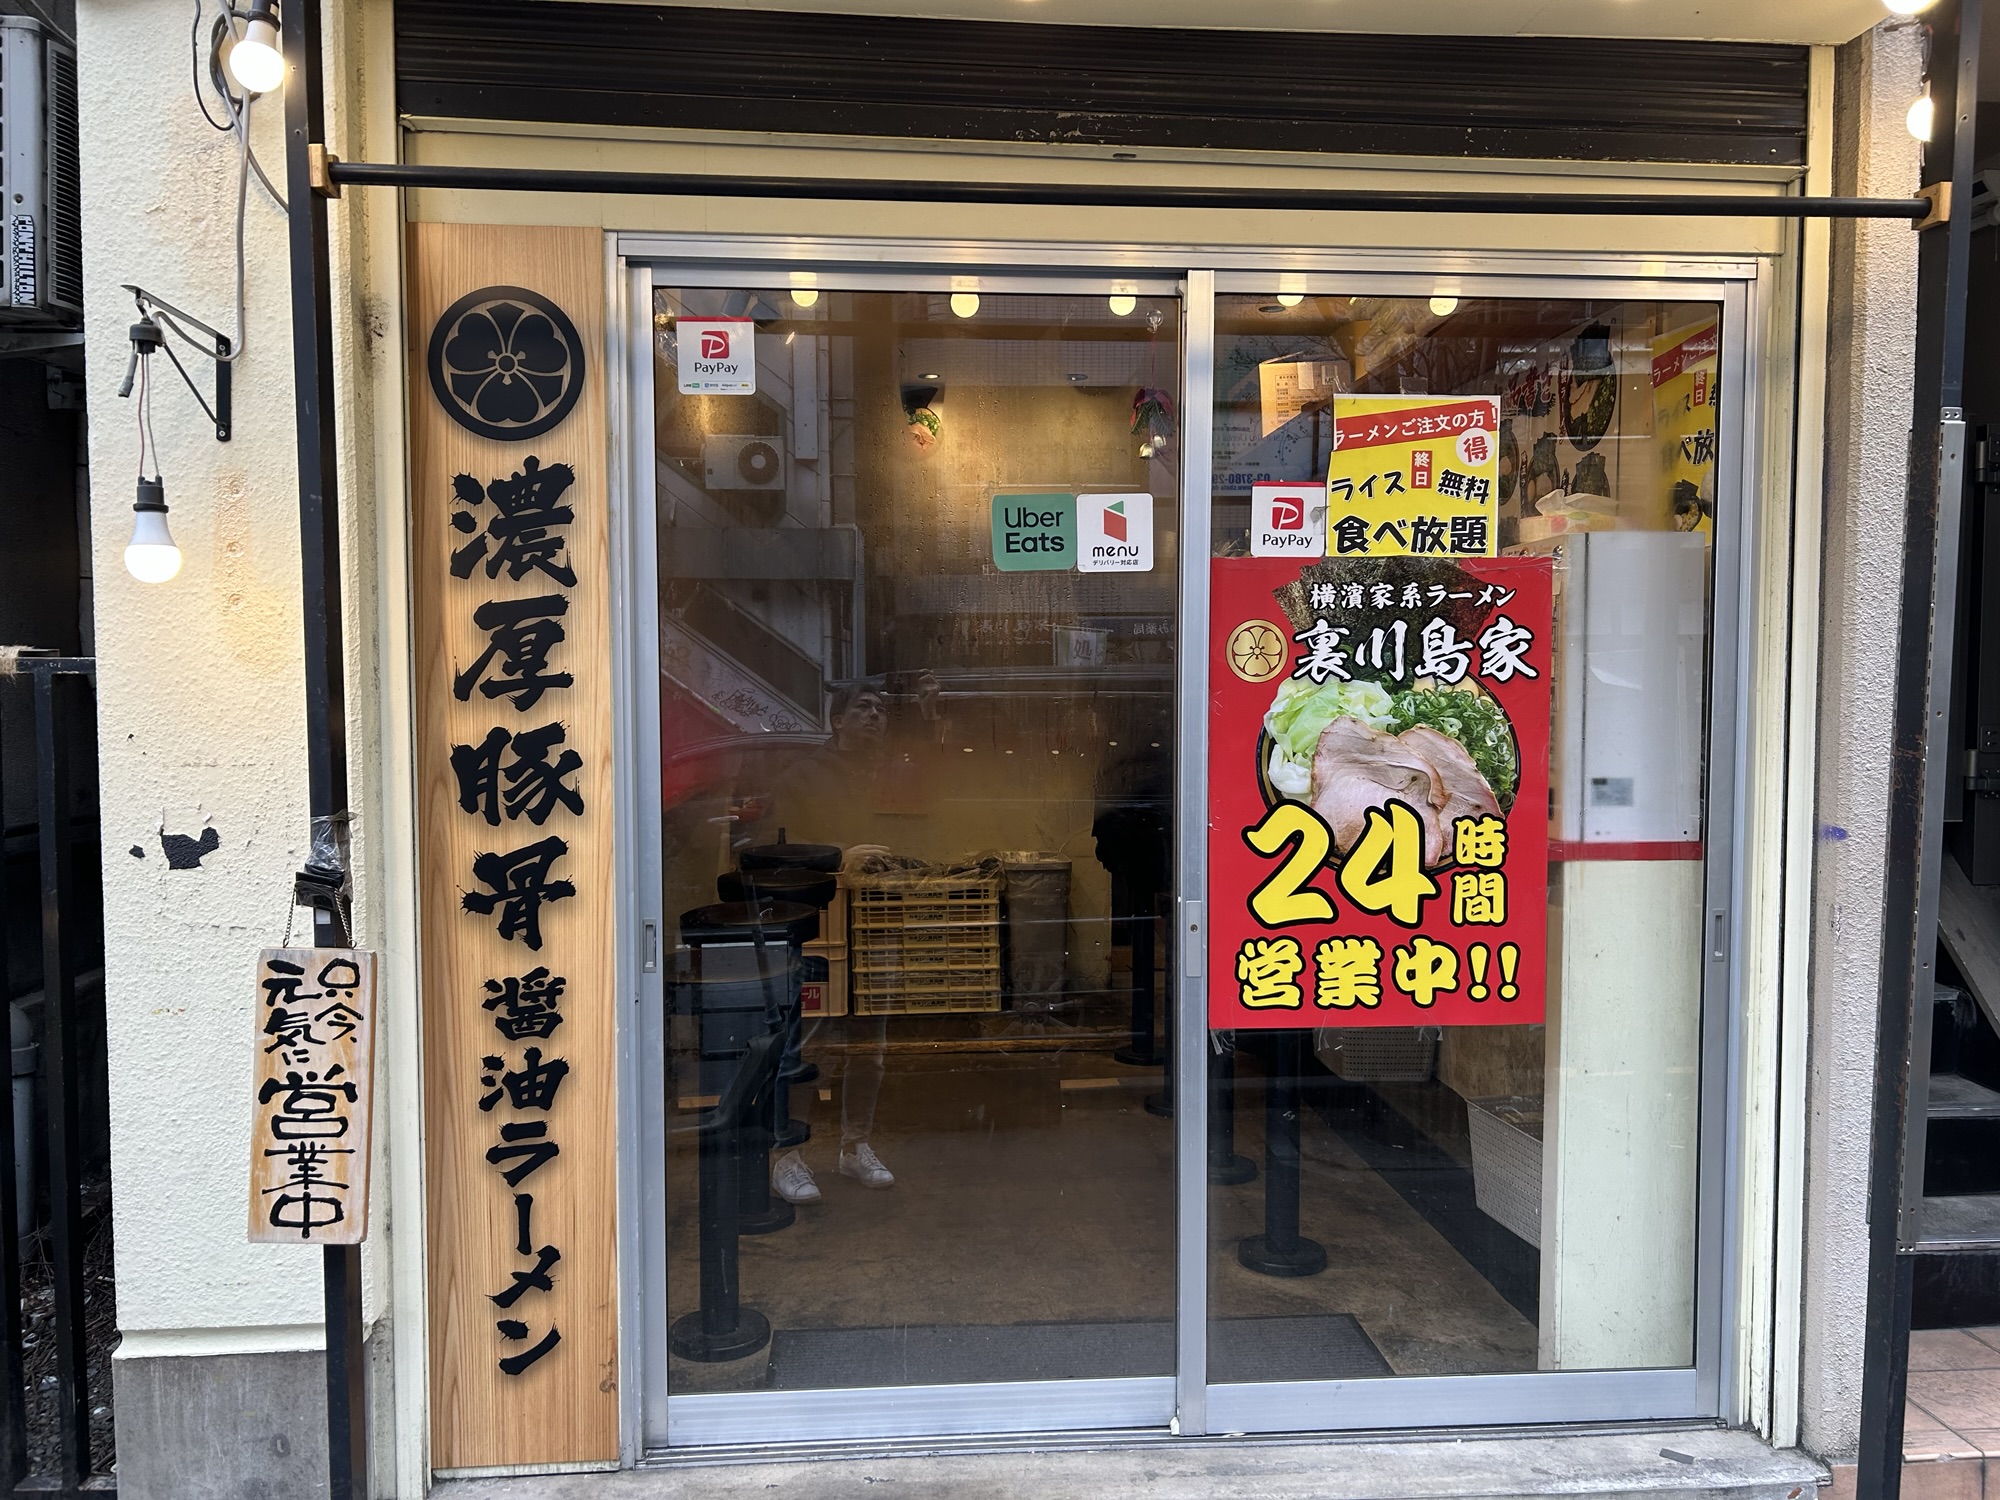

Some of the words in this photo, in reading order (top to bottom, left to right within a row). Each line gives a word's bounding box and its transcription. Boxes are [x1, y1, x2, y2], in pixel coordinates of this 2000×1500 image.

[18, 253, 36, 305] HILTON
[694, 362, 738, 375] PayPay
[1462, 435, 1489, 463] 得
[1331, 471, 1406, 501] ライス
[1413, 451, 1430, 486] 終日
[1437, 468, 1490, 505] 無料
[1004, 507, 1064, 528] Uber
[1332, 514, 1488, 555] 食べ放題
[1005, 532, 1065, 553] Eats
[1092, 545, 1139, 557] menu
[1262, 533, 1313, 549] PayPay
[1309, 582, 1517, 610] 横濱家系ラーメン
[1292, 616, 1539, 684] 裏川島家
[1242, 798, 1442, 929] 24
[1450, 814, 1509, 926] 時間
[450, 455, 585, 1376] 濃厚豚骨醤油ラーメン
[1235, 935, 1520, 1010] 営業中!!
